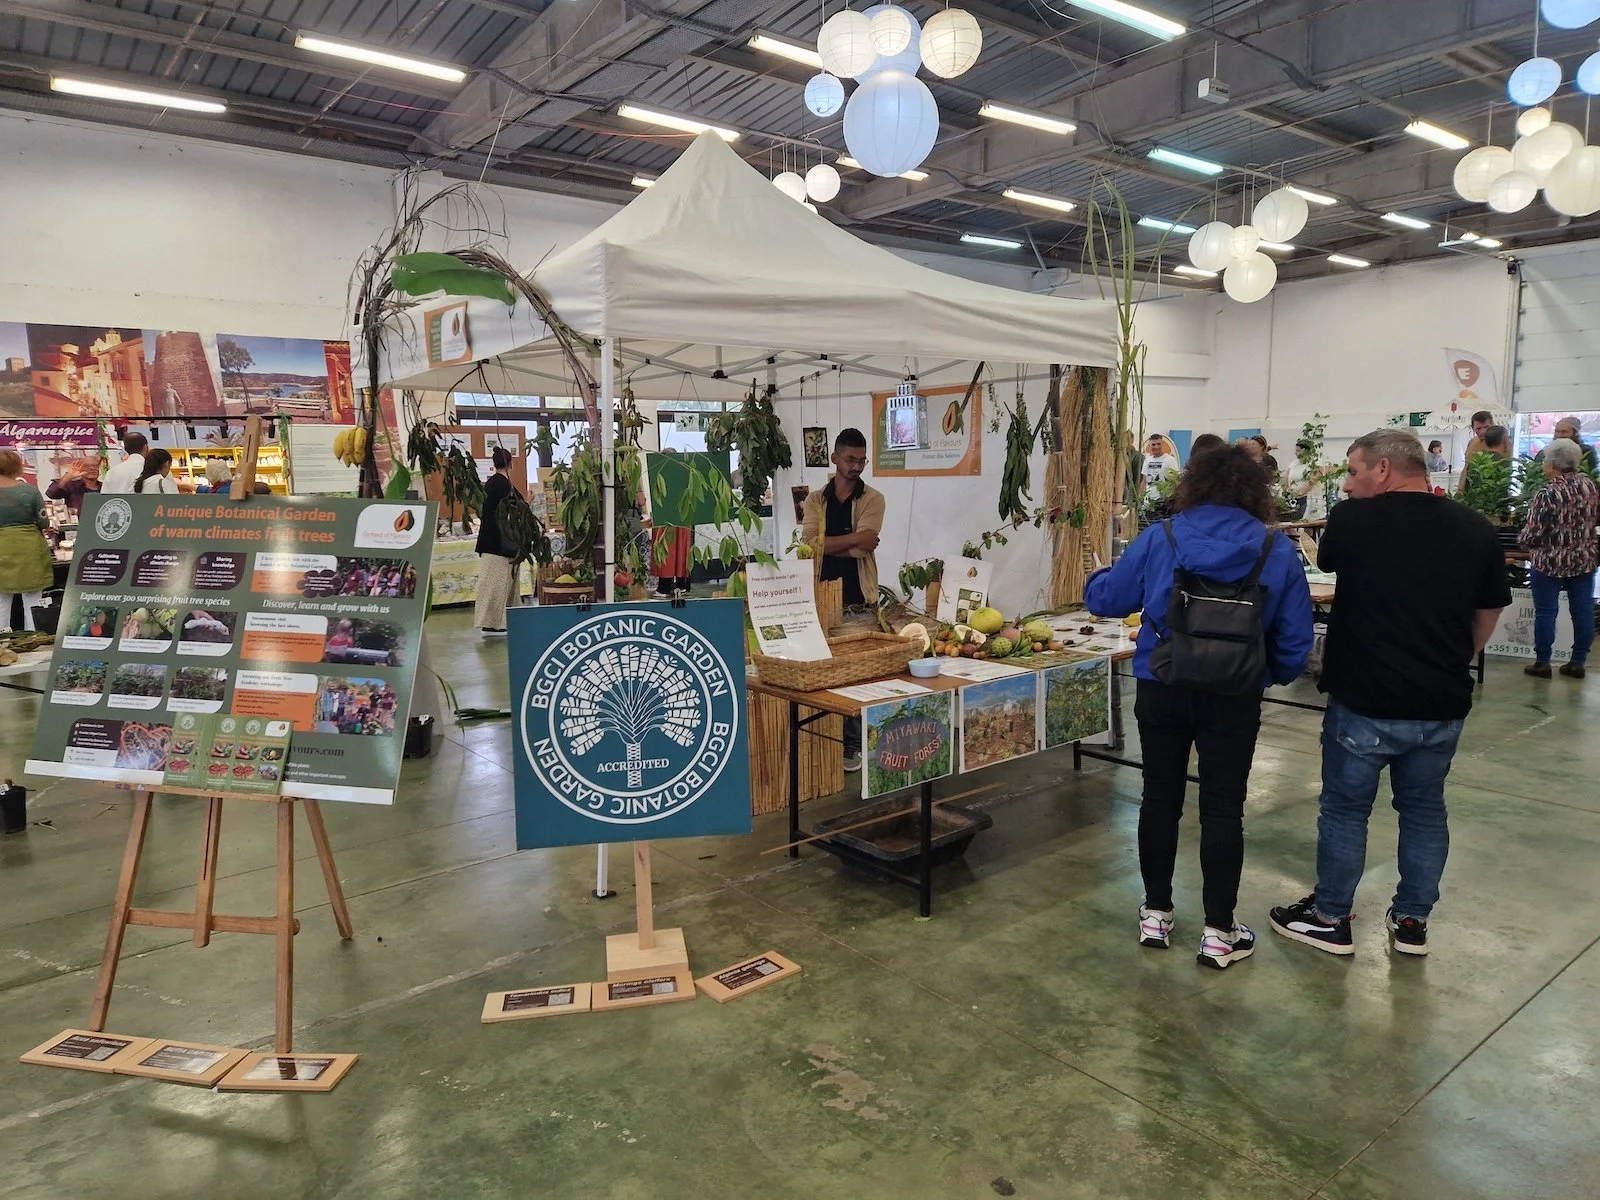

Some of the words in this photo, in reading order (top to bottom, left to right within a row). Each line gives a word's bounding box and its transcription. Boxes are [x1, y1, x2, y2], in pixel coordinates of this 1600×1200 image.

[154, 505, 164, 517] A
[167, 506, 213, 521] unique
[215, 505, 280, 520] Botanical
[283, 507, 337, 521] Garden
[150, 524, 166, 538] of
[166, 527, 201, 538] warm
[205, 526, 262, 540] climates
[297, 529, 336, 542] trees
[80, 592, 106, 602] Explore
[121, 595, 136, 603] 300
[136, 594, 172, 605] surprising
[171, 595, 189, 605] fruit
[188, 597, 204, 605] tree
[204, 596, 231, 607] species
[752, 590, 769, 598] Help
[770, 586, 798, 597] yourself
[1512, 590, 1533, 599] lima
[262, 599, 298, 610] Discover,
[298, 601, 320, 610] learn
[320, 602, 336, 611] and
[337, 604, 359, 613] grow
[360, 603, 379, 613] with
[379, 606, 390, 614] us
[1515, 617, 1532, 628] fru
[1487, 644, 1510, 652] +351
[1513, 645, 1530, 654] 919
[531, 658, 566, 709] BGCI
[560, 618, 656, 661] BOTANIC
[662, 625, 728, 697] GARDEN
[885, 721, 937, 744] MIYAWAKI
[292, 746, 345, 757] vours.com
[698, 721, 730, 773] BGCI
[880, 750, 909, 768] FRUIT
[914, 733, 943, 764] FOREST
[596, 758, 670, 773] ACCREDITED
[534, 738, 605, 810] GARDEN
[610, 772, 704, 815] BOTANIC
